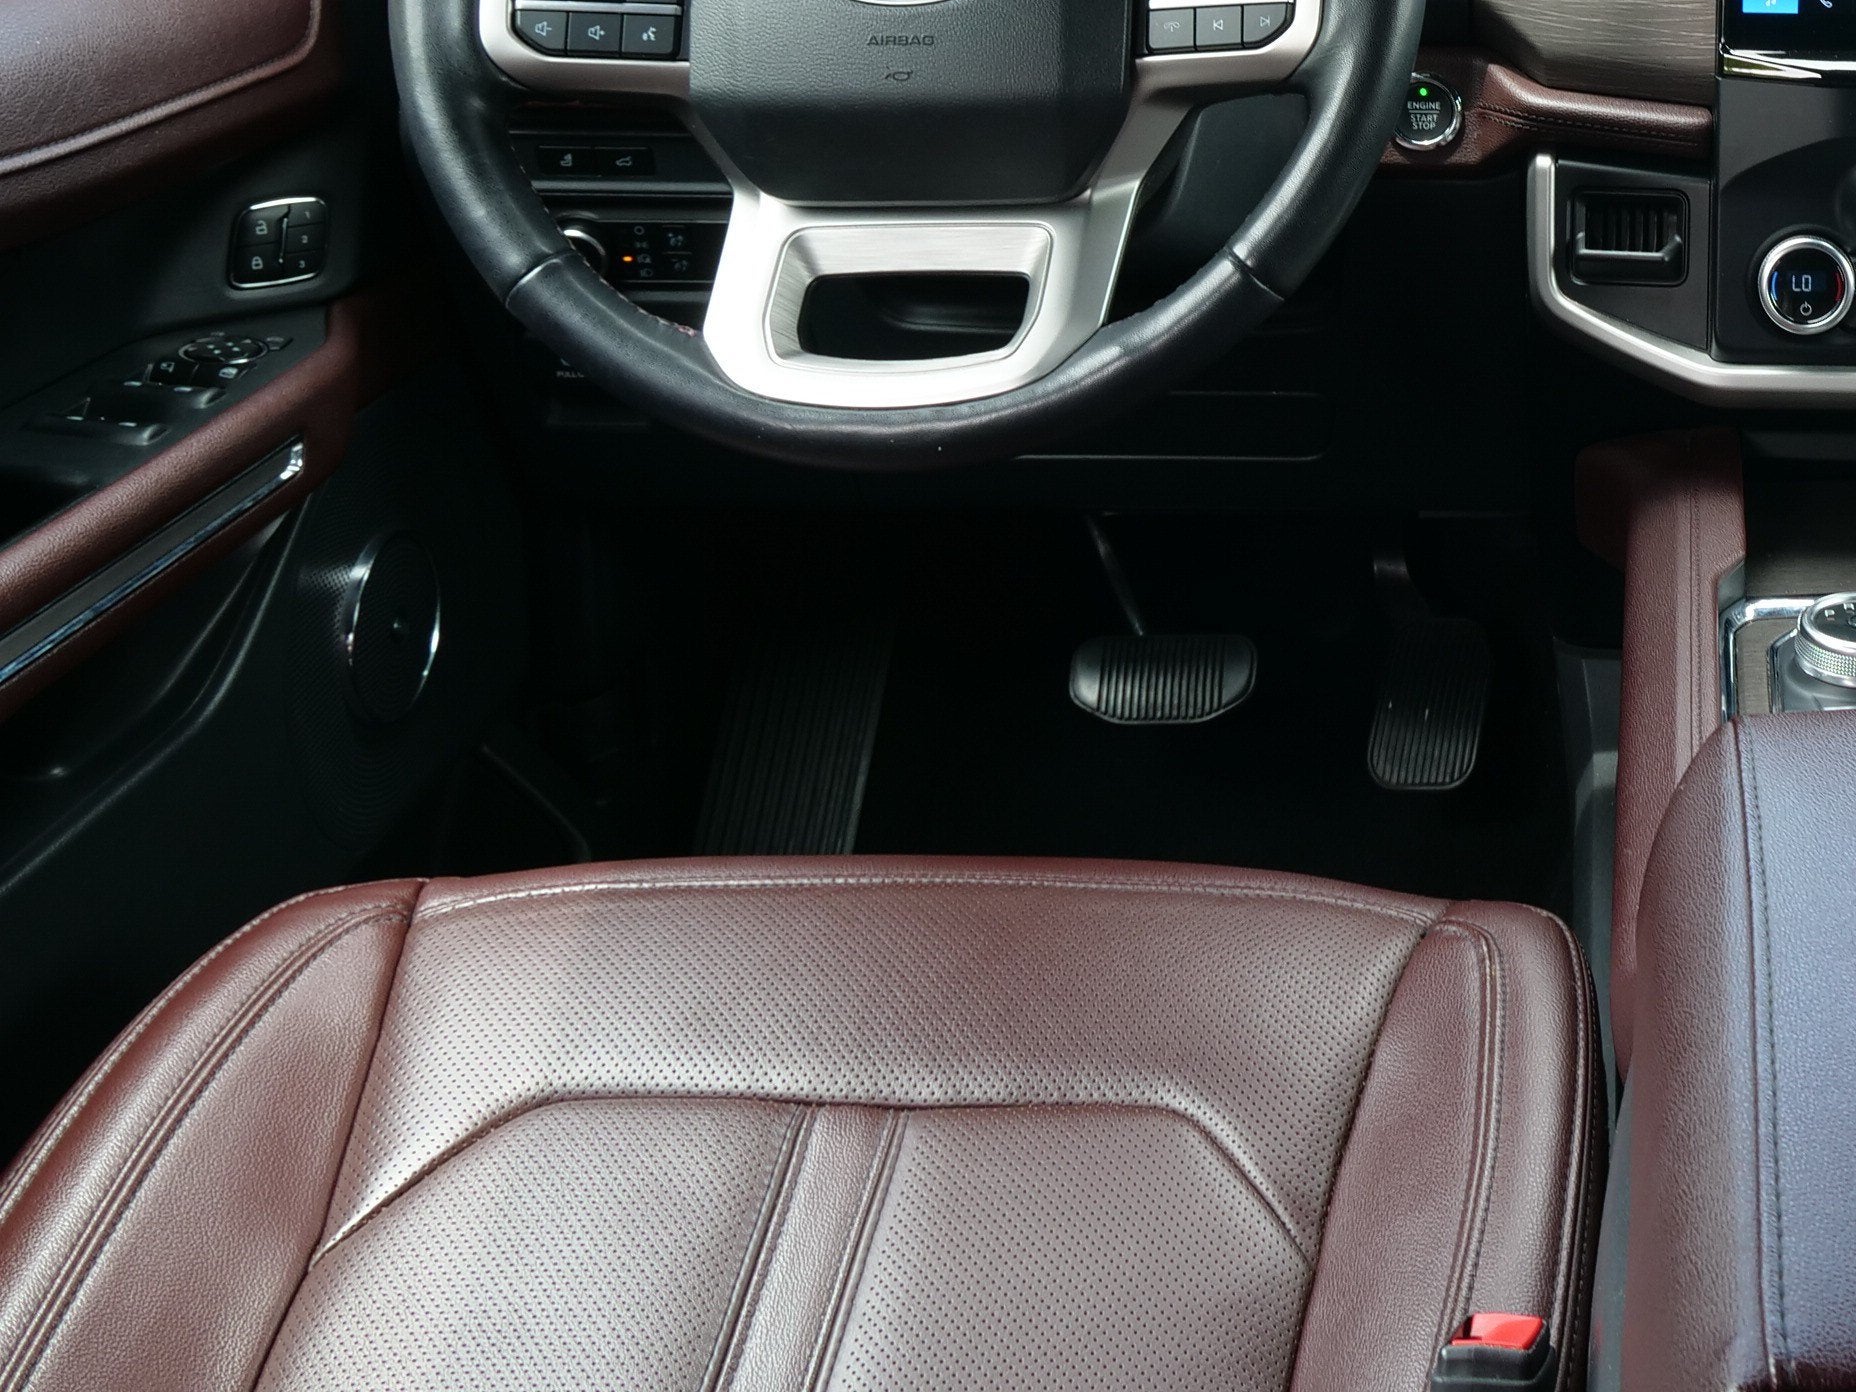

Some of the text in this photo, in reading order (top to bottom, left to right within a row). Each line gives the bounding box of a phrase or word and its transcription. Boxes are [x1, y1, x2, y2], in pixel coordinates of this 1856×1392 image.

[866, 35, 935, 46] AIRBAG
[1407, 101, 1441, 110] ENGINE
[1410, 114, 1437, 123] START
[1412, 121, 1436, 130] STOP
[1824, 609, 1835, 617] P
